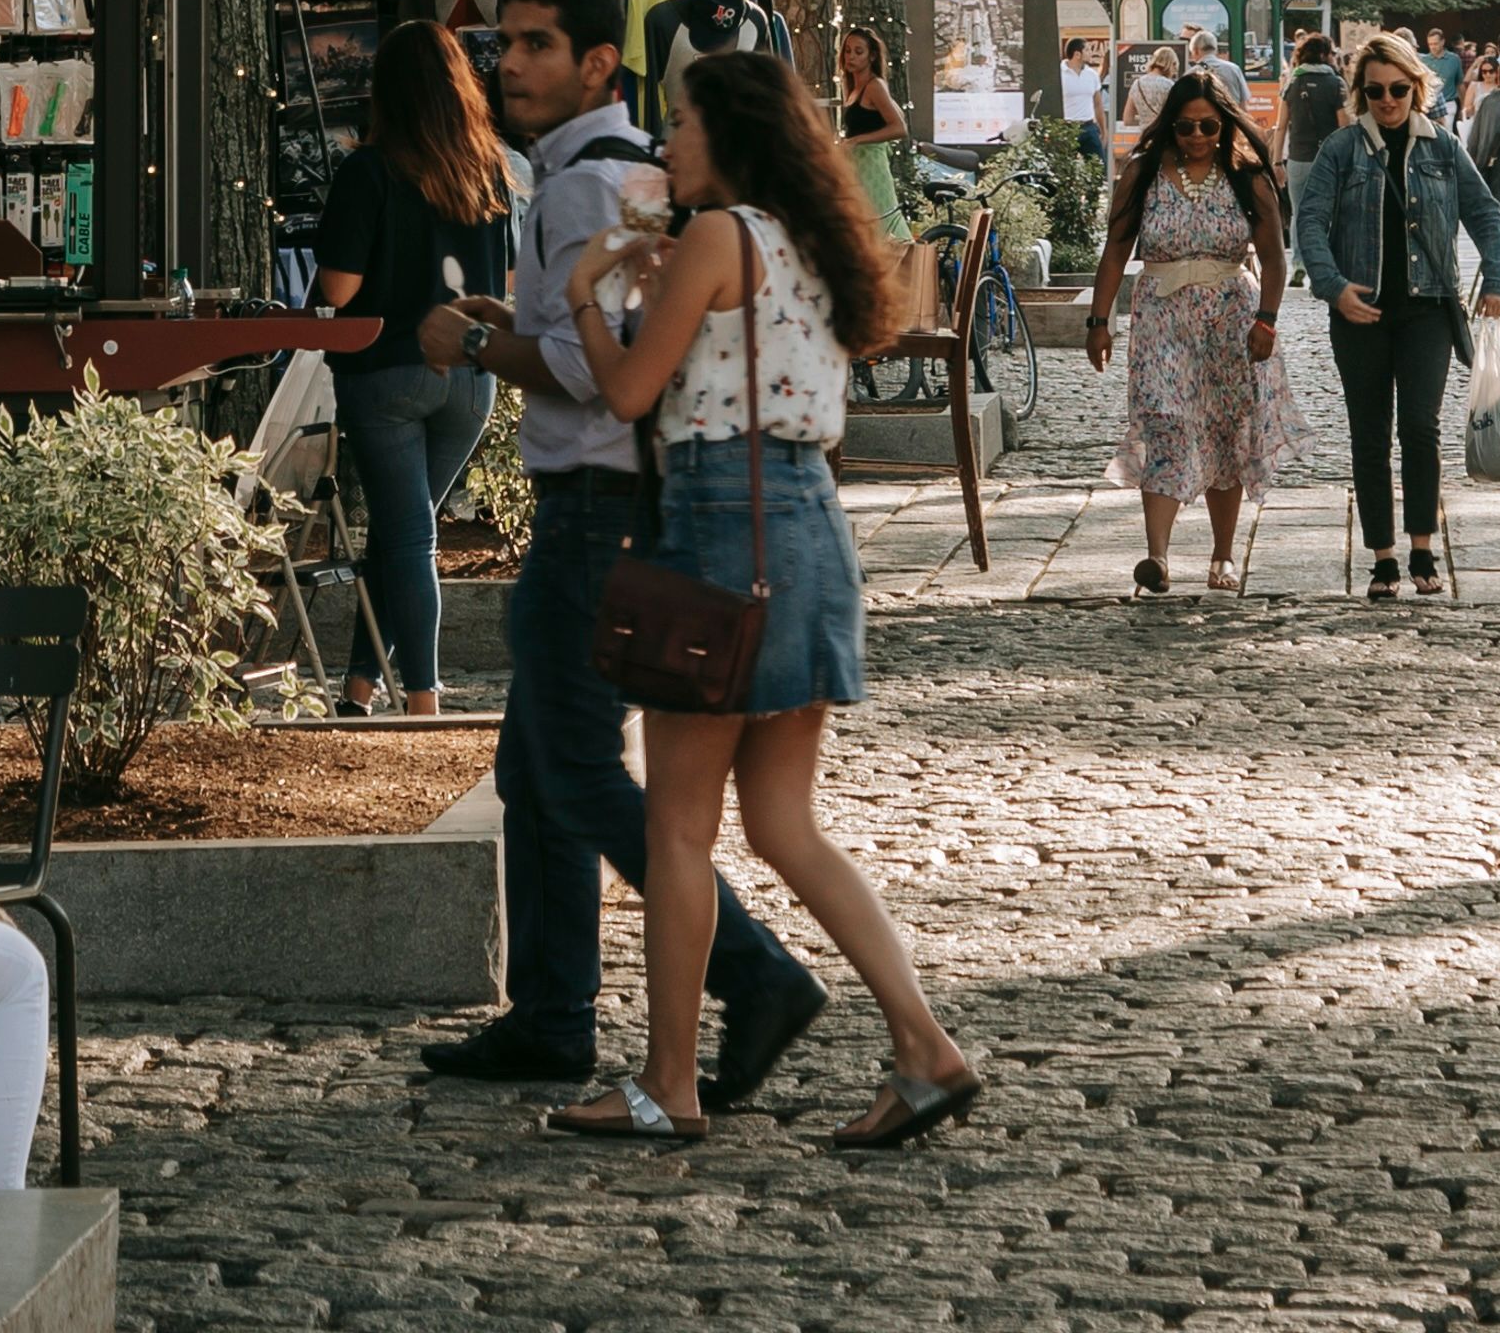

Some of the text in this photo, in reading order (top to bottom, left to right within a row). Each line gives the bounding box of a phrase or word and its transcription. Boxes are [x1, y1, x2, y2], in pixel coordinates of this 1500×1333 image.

[1128, 53, 1151, 63] HIST
[1133, 64, 1147, 72] TO
[78, 213, 90, 255] CABLE
